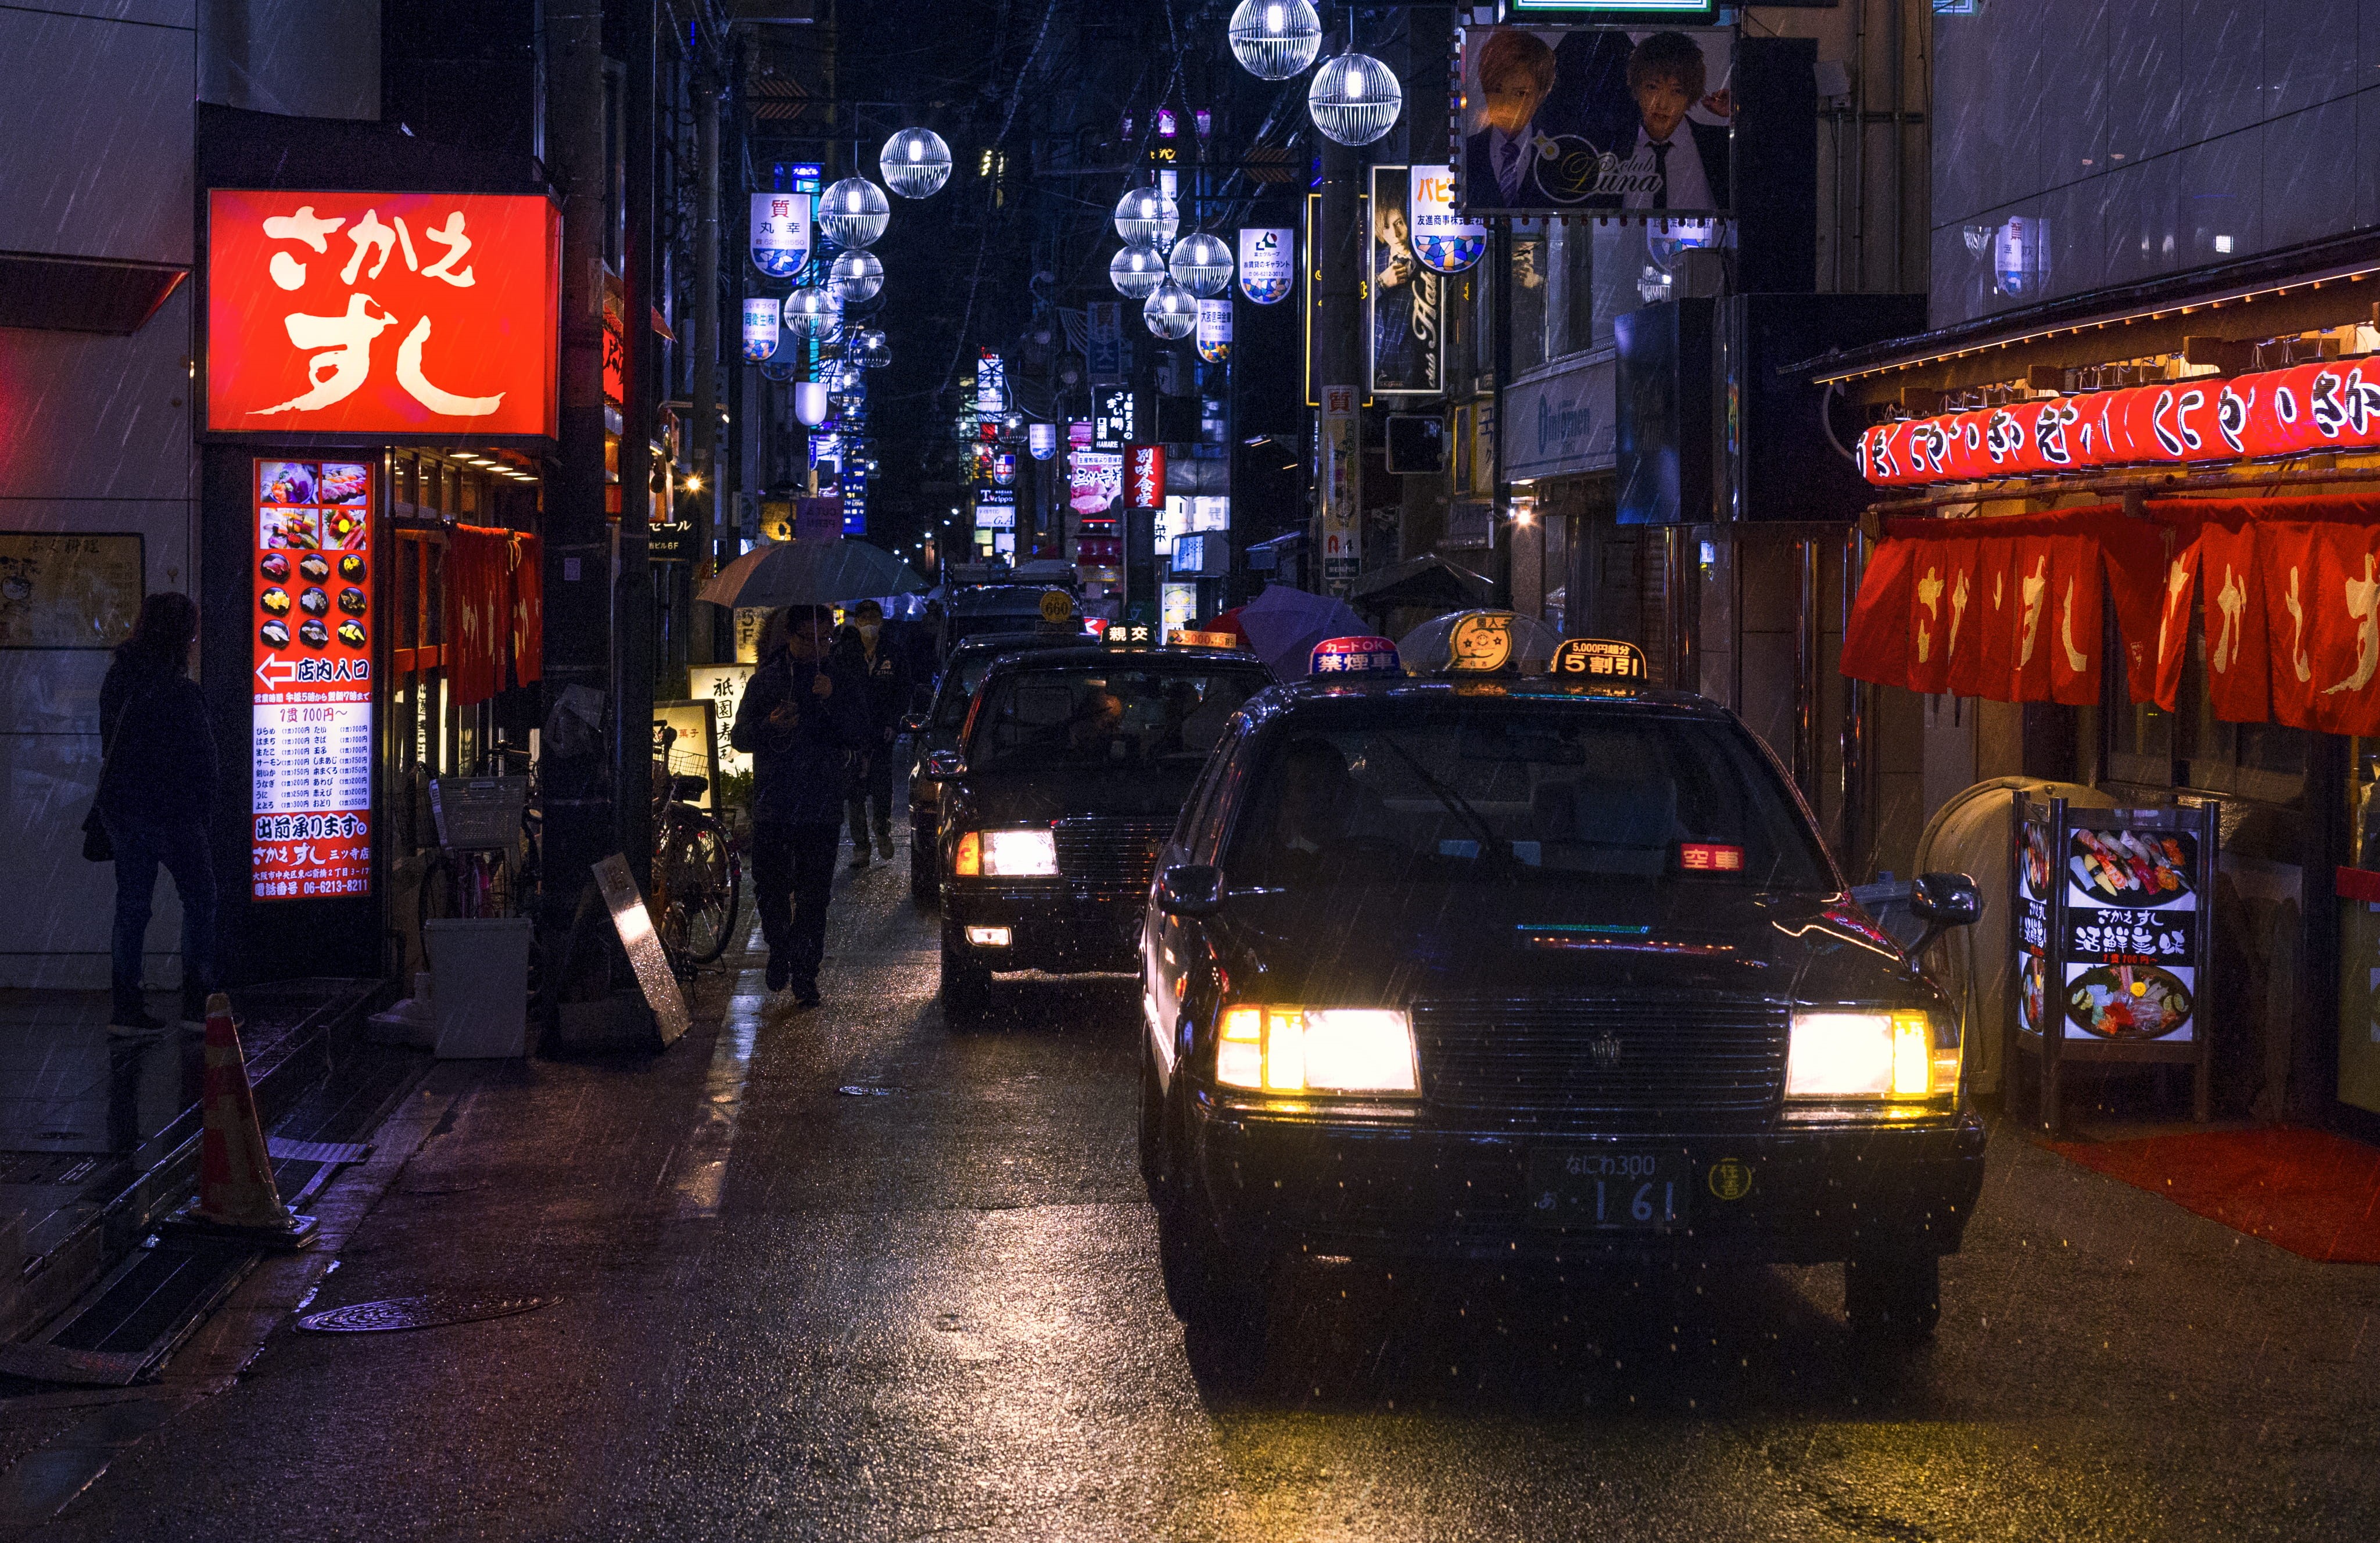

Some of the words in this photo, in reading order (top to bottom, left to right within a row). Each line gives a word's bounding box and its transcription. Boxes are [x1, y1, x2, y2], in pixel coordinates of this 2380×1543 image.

[1621, 155, 1654, 172] club
[1417, 177, 1455, 202] パピ
[771, 199, 790, 218] 質
[760, 221, 801, 235] 丸幸
[263, 206, 476, 291] さかえ
[245, 293, 506, 417] すし
[1109, 626, 1148, 641] 親交
[297, 658, 370, 682] 店内入口
[1318, 652, 1395, 672] 禁煙車
[1565, 654, 1638, 676] 5割引
[256, 813, 367, 841] 出前承ります。
[1684, 848, 1740, 870] 空車
[255, 881, 298, 897] 電話番号
[303, 879, 368, 894] 06-6213-8211
[2075, 926, 2185, 955] 活鮮美味
[1597, 1181, 1673, 1221] 161
